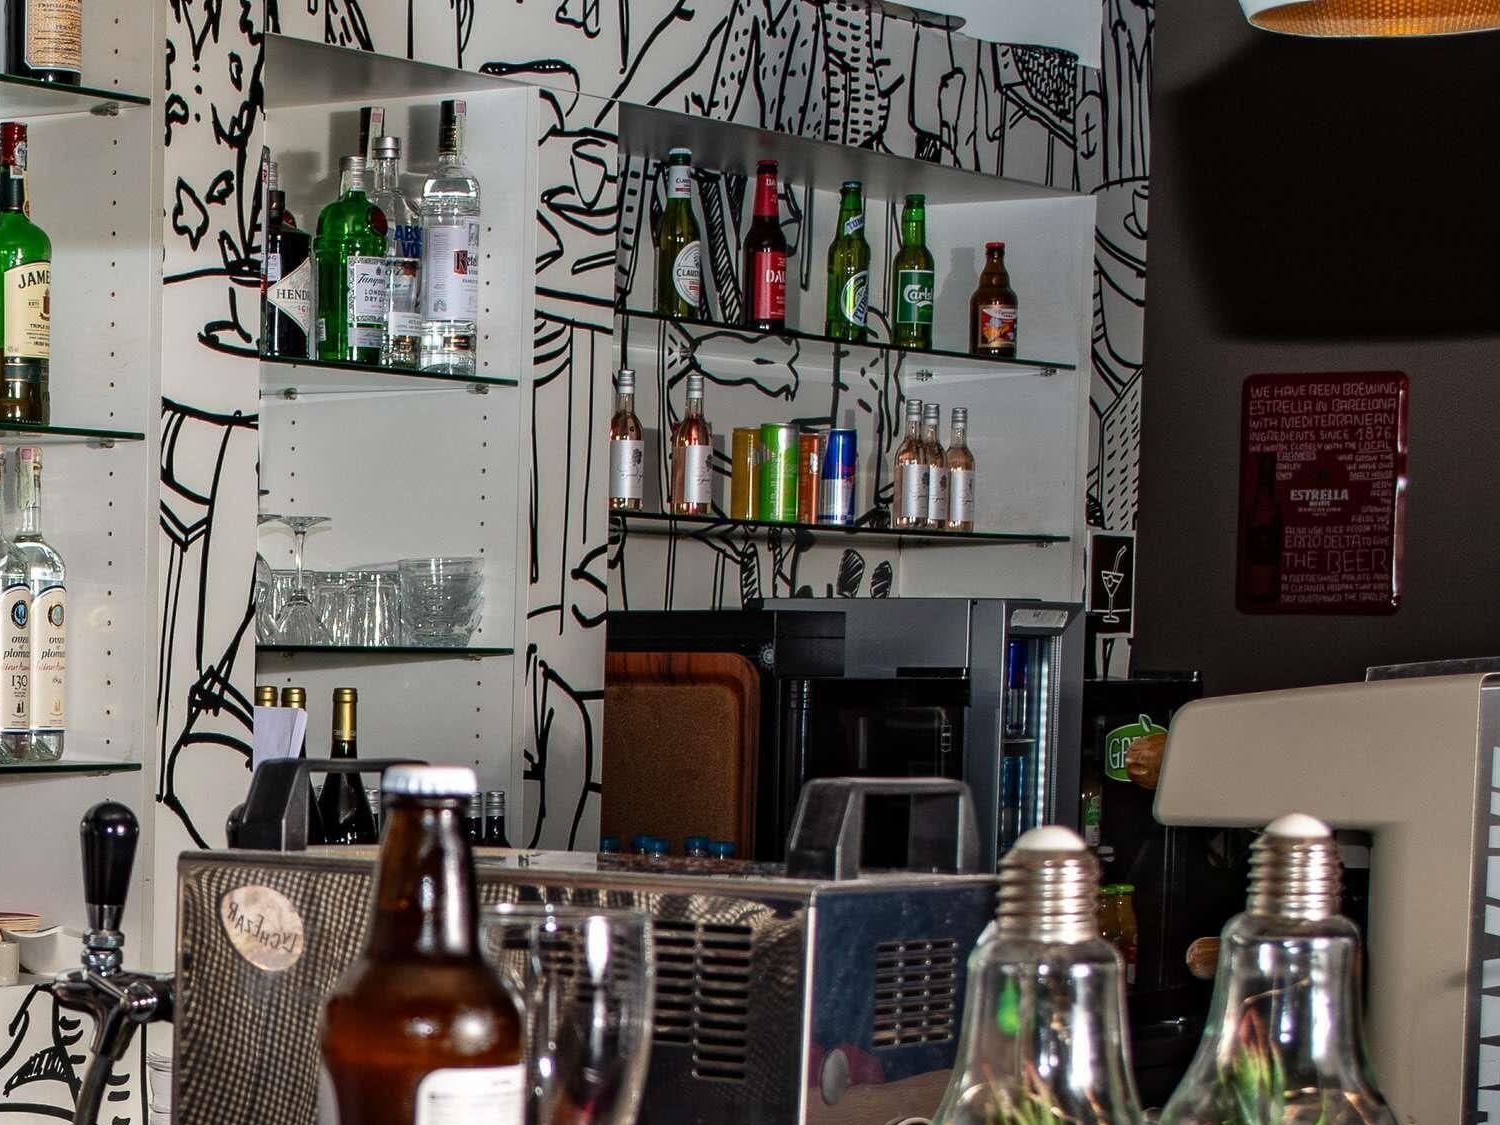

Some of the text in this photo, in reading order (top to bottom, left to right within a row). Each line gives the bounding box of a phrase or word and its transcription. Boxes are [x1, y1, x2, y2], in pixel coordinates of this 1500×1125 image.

[1251, 382, 1397, 399] WE HAVE BEEN BREWING
[1250, 399, 1313, 416] ESTRELLA
[1332, 397, 1396, 411] BARCELONA
[1281, 413, 1395, 428] MEDITERRANEAN
[1250, 430, 1316, 442] INGREDIENTS
[1289, 488, 1349, 501] ESTRELLA
[1323, 534, 1361, 549] DELTA
[1284, 548, 1387, 574] THE BEER
[11, 675, 28, 689] 130
